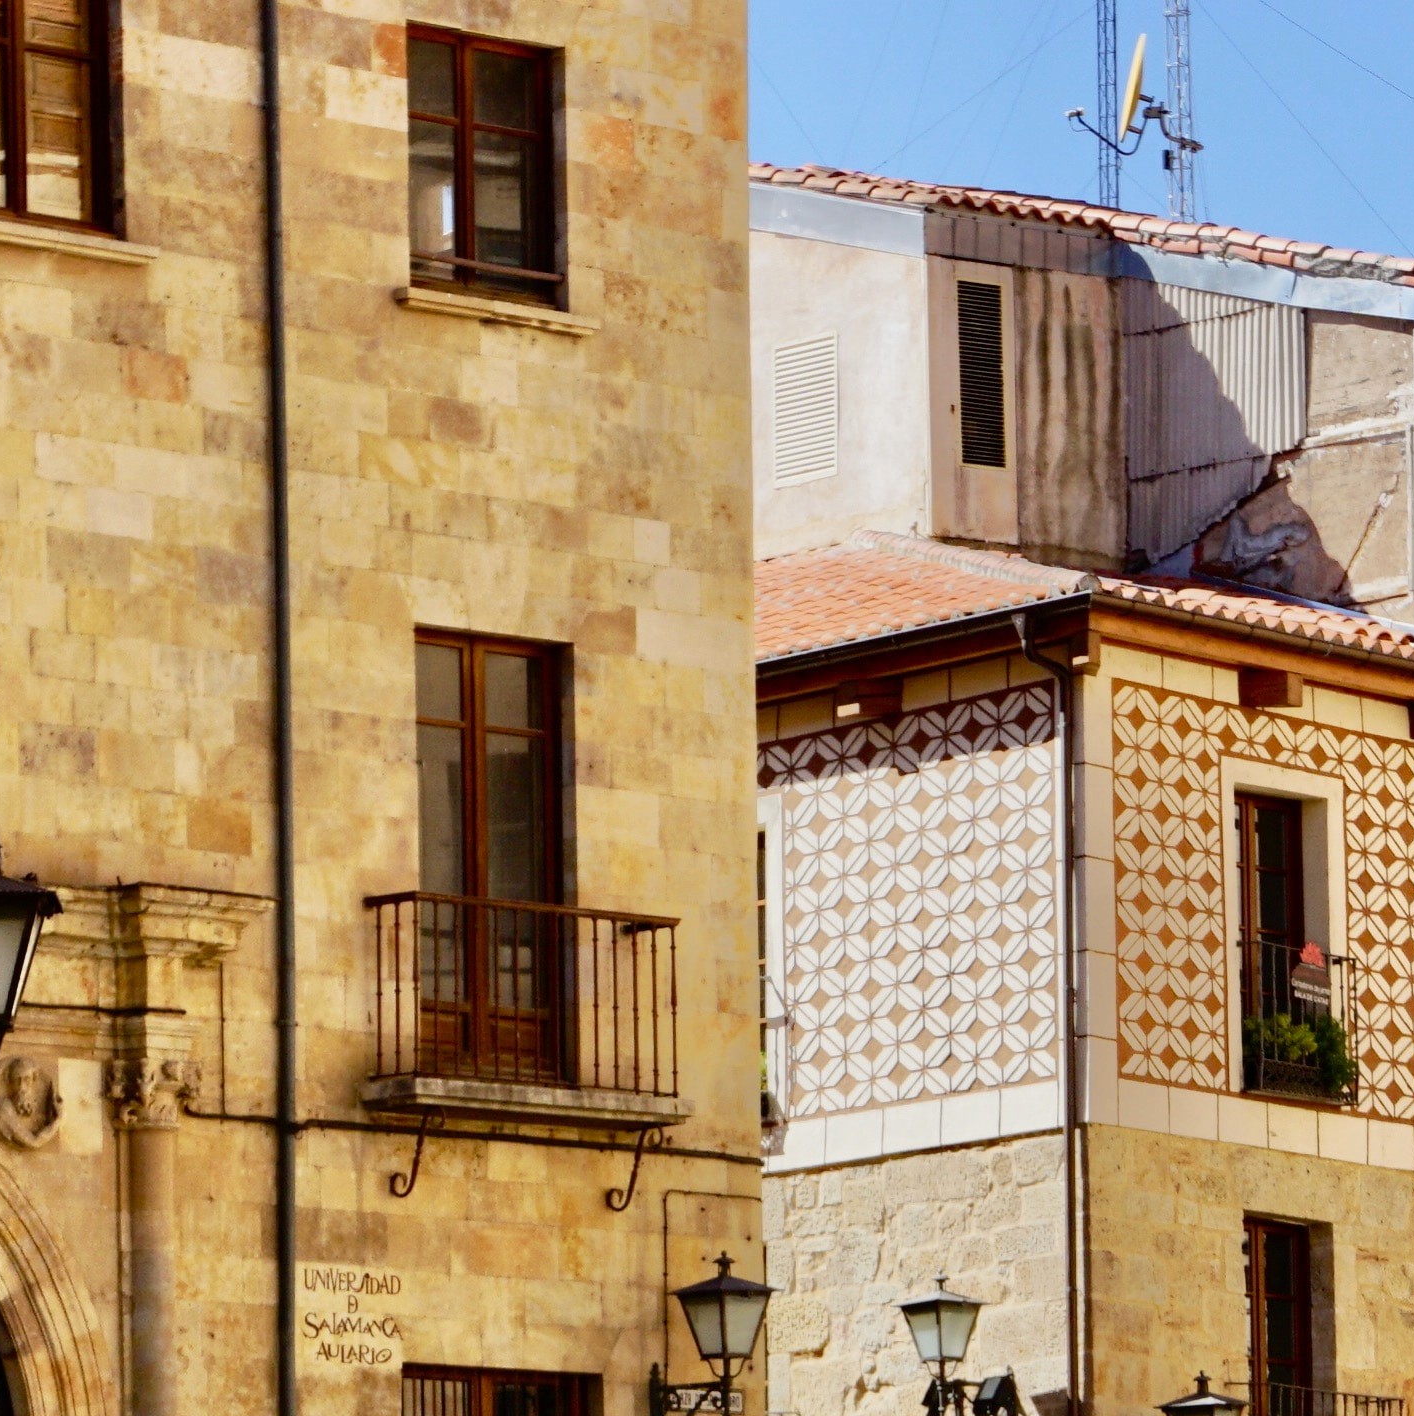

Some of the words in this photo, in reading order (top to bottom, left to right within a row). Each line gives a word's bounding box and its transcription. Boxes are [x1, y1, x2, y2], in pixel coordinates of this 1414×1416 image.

[303, 1268, 401, 1295] UNIVERSIDAD
[302, 1312, 404, 1341] SALAMANCA
[316, 1341, 392, 1366] AULARIO
